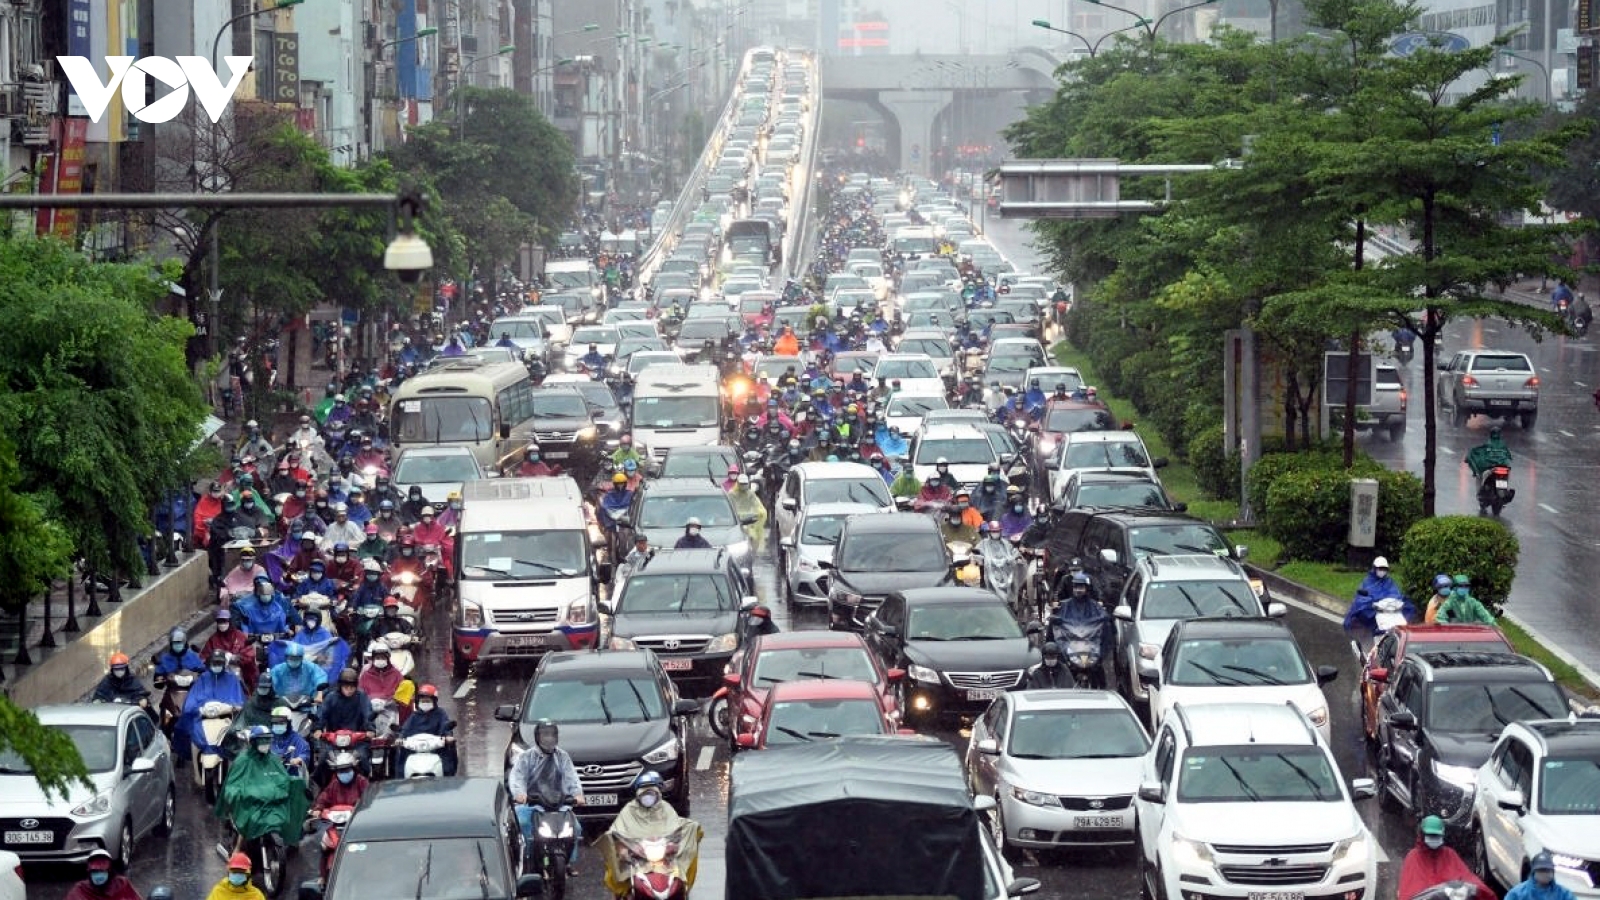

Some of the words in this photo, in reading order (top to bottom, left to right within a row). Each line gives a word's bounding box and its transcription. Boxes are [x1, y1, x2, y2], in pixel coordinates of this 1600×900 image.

[276, 37, 296, 50] To
[278, 53, 295, 66] Co
[277, 68, 297, 81] To
[278, 86, 295, 97] Co
